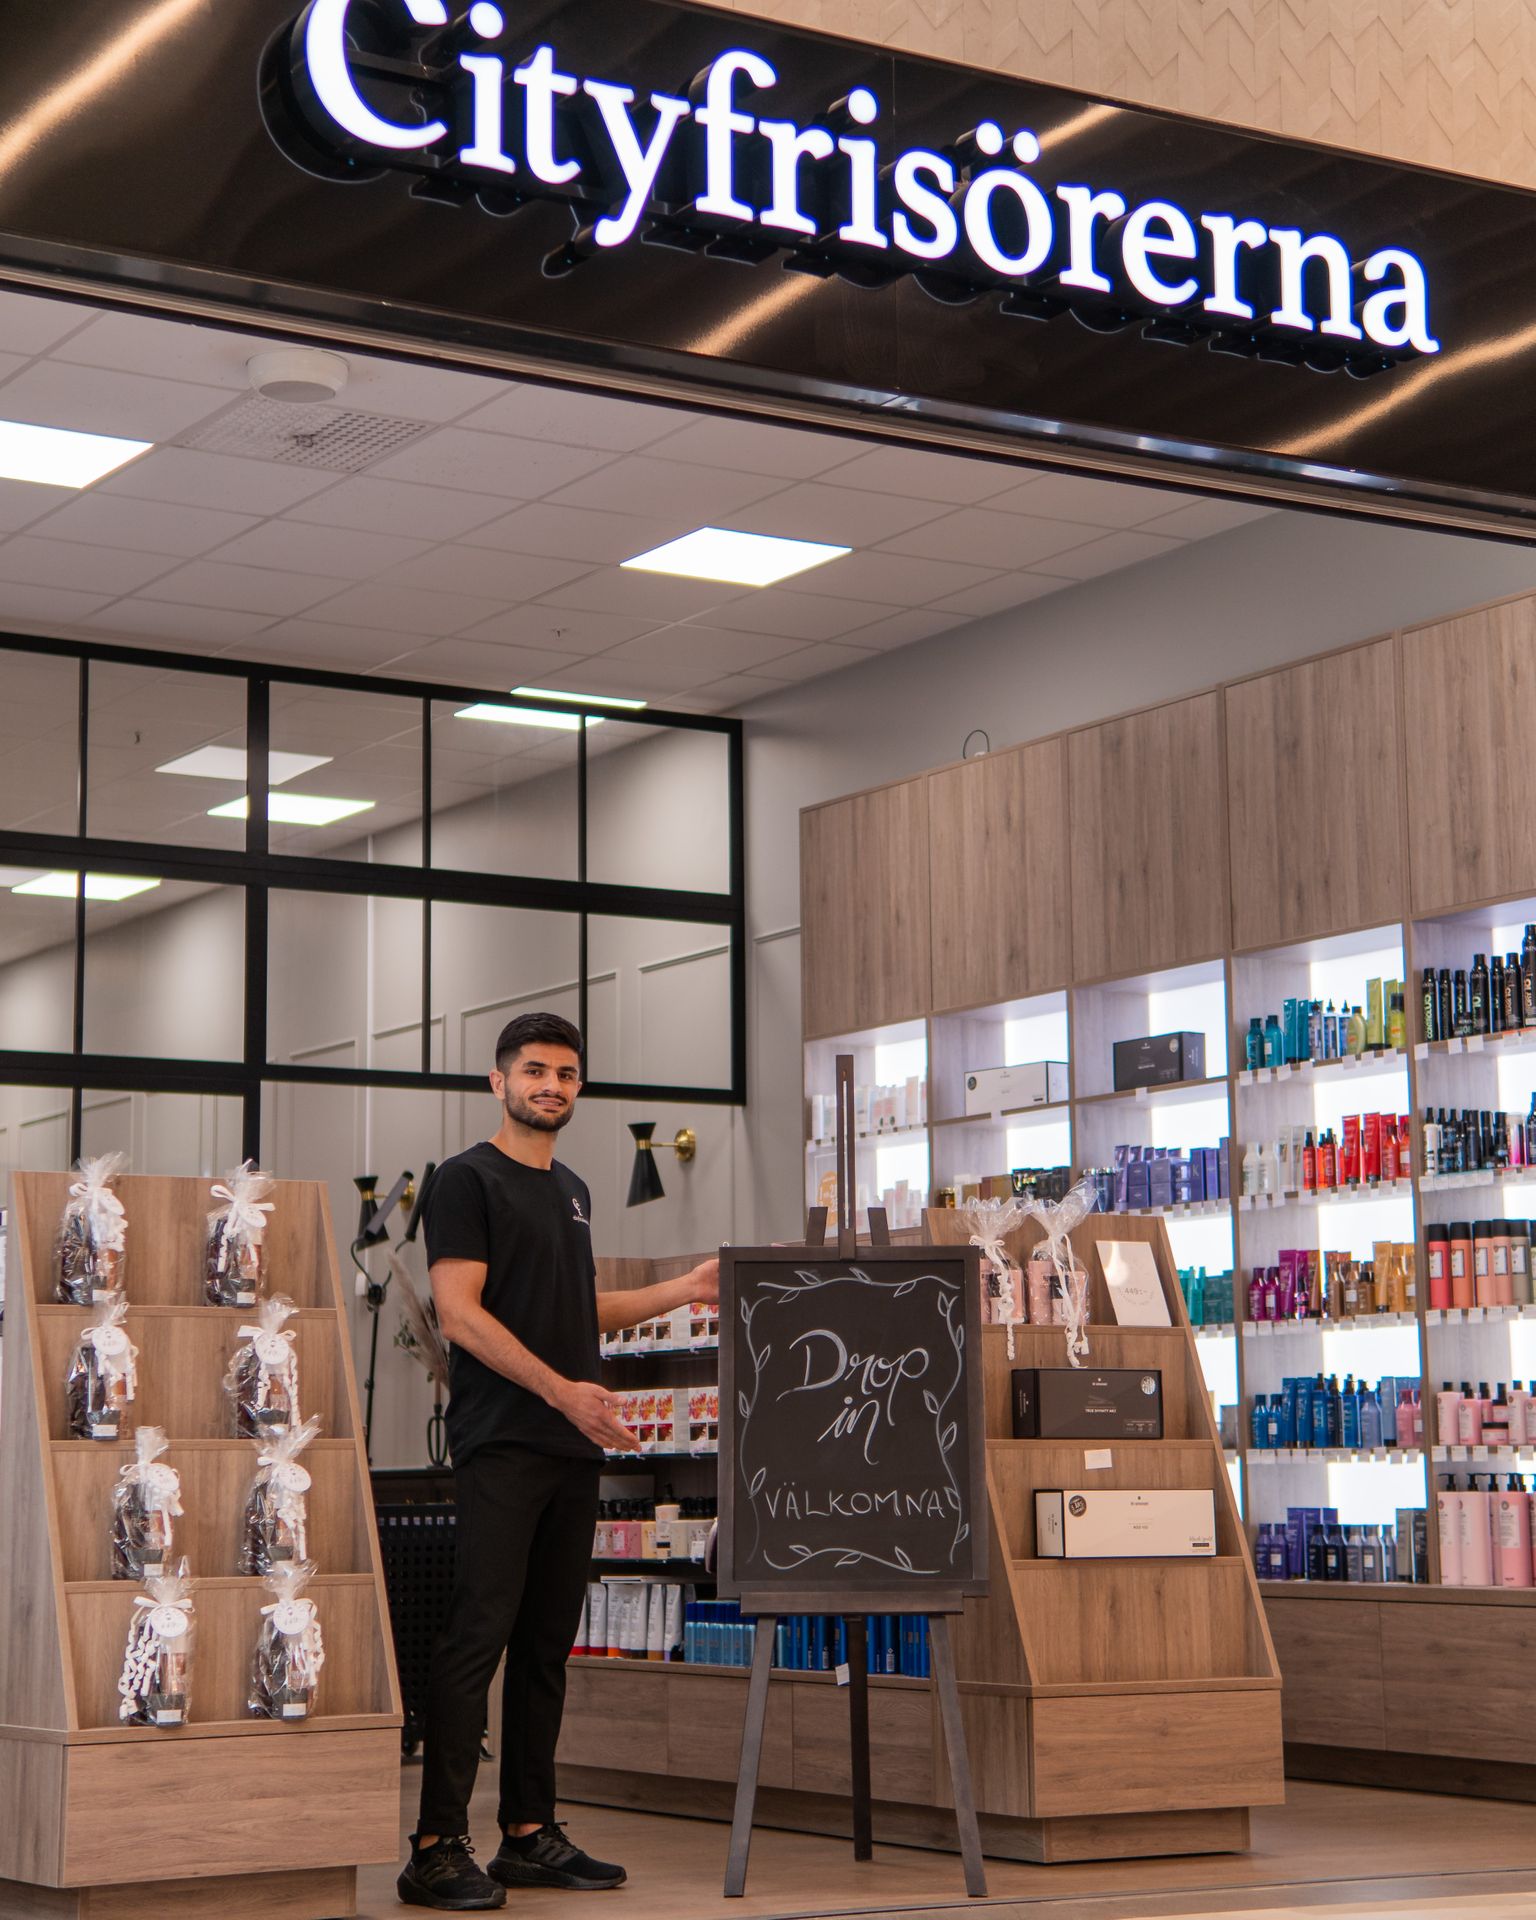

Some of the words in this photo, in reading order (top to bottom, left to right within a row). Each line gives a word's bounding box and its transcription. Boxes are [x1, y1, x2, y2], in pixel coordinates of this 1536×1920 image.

[303, 0, 1441, 354] Cityfrisörerna
[776, 1329, 929, 1426] Drop
[817, 1396, 880, 1465] in
[765, 1482, 946, 1520] VÄLKOMNA
